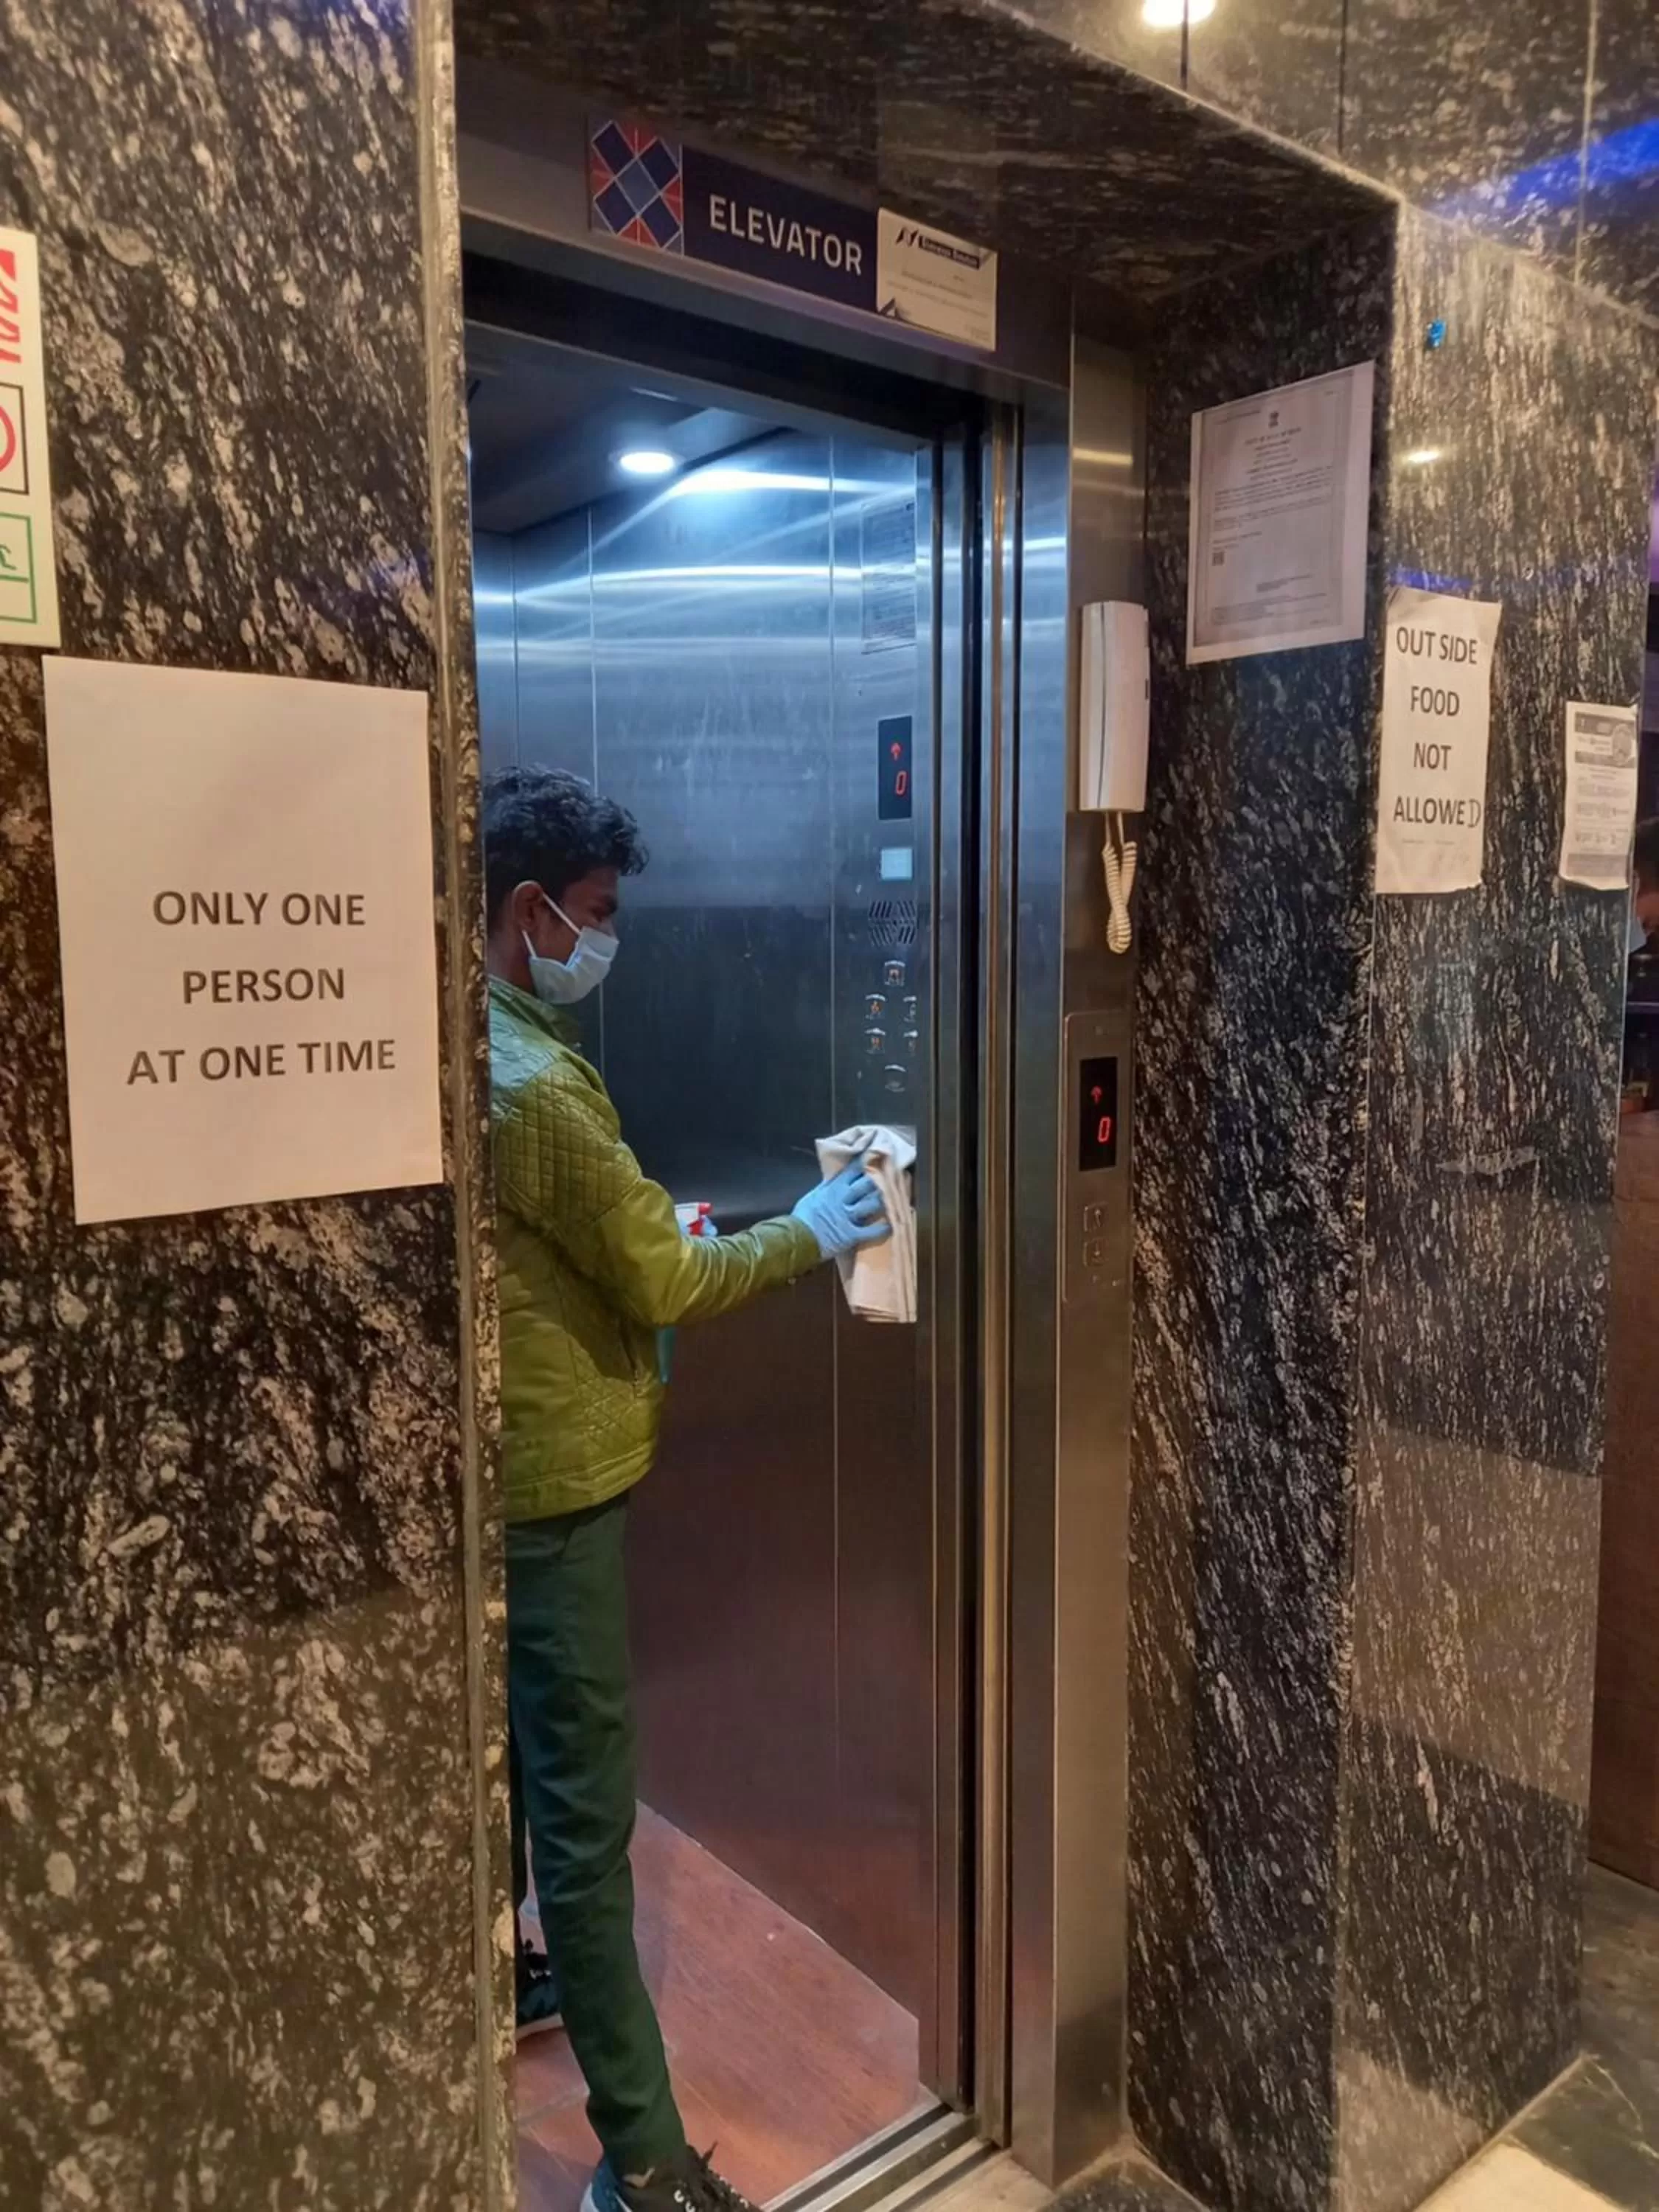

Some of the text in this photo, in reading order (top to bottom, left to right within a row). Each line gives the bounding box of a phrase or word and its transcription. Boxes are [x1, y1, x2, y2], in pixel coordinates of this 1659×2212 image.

[709, 194, 863, 276] ELEVATOR
[1411, 685, 1460, 717] FOOD
[1413, 742, 1451, 771] NOT
[1394, 796, 1481, 828] ALLOWED
[153, 891, 366, 926] ONLY ONE
[183, 967, 344, 1004] PERSON
[127, 1039, 395, 1085] AT ONE TIME
[1097, 1116, 1110, 1143] 0
